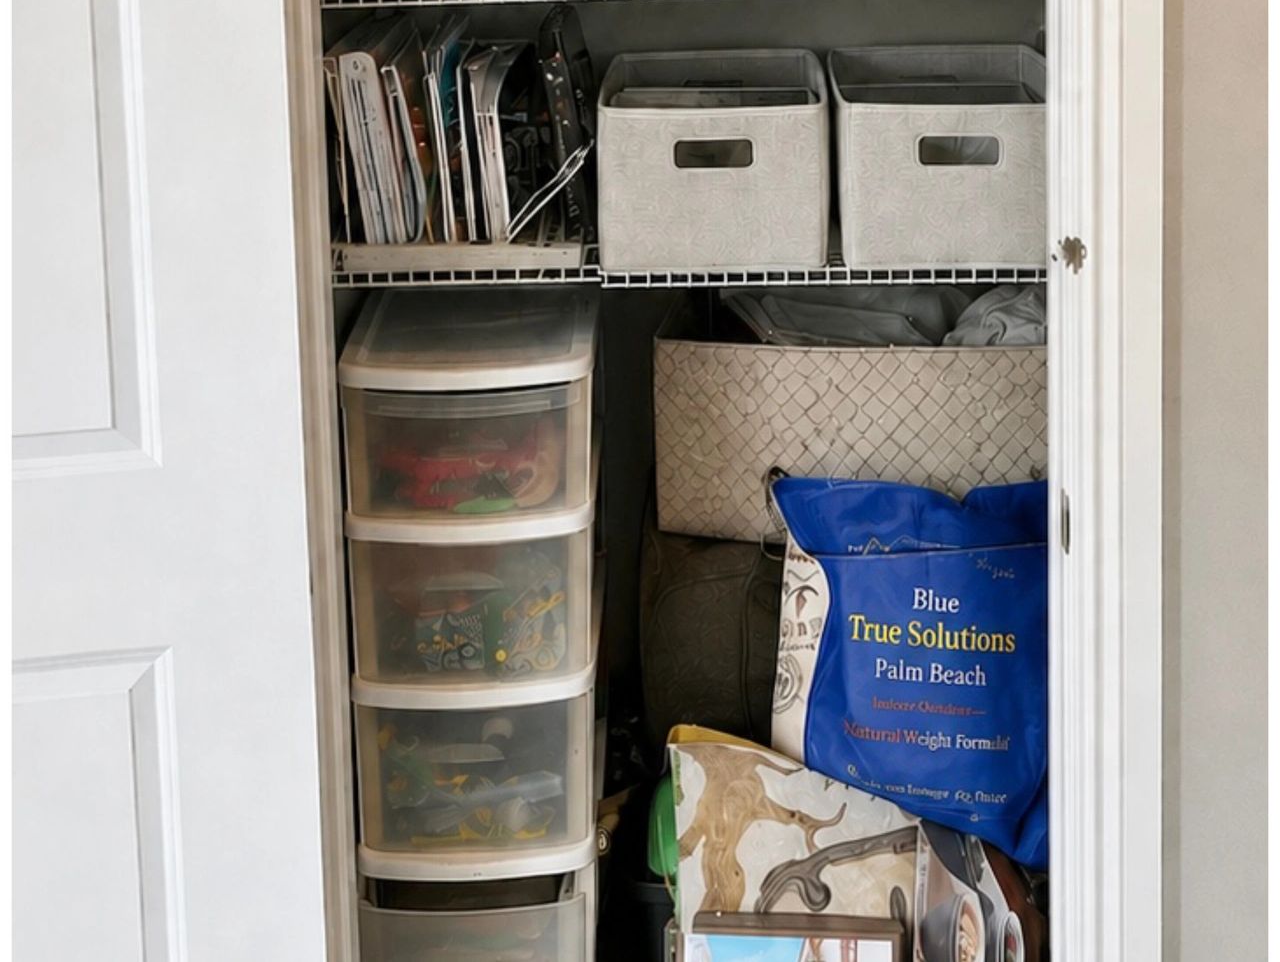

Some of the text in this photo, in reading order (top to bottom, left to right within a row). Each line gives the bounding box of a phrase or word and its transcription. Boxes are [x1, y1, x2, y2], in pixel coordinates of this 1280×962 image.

[911, 587, 961, 614] Blue
[848, 614, 1017, 654] True Solutions
[874, 657, 988, 687] Palm Beach
